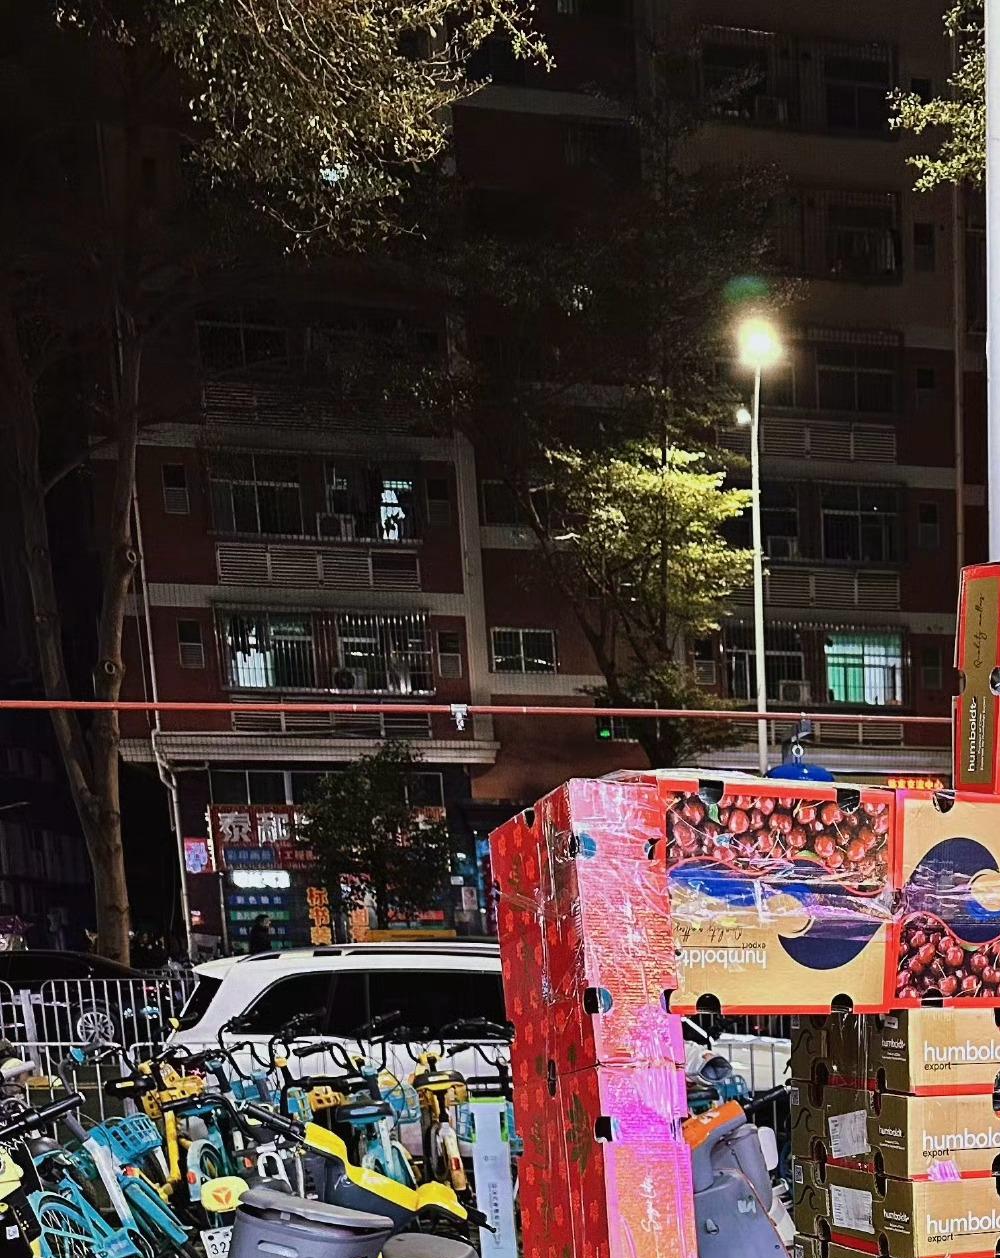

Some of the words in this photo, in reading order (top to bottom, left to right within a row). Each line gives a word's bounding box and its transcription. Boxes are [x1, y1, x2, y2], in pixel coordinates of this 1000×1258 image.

[967, 696, 977, 772] humboldt
[675, 950, 767, 969] humboldt
[924, 1061, 952, 1070] export
[922, 1147, 950, 1157] export
[927, 1233, 953, 1242] export
